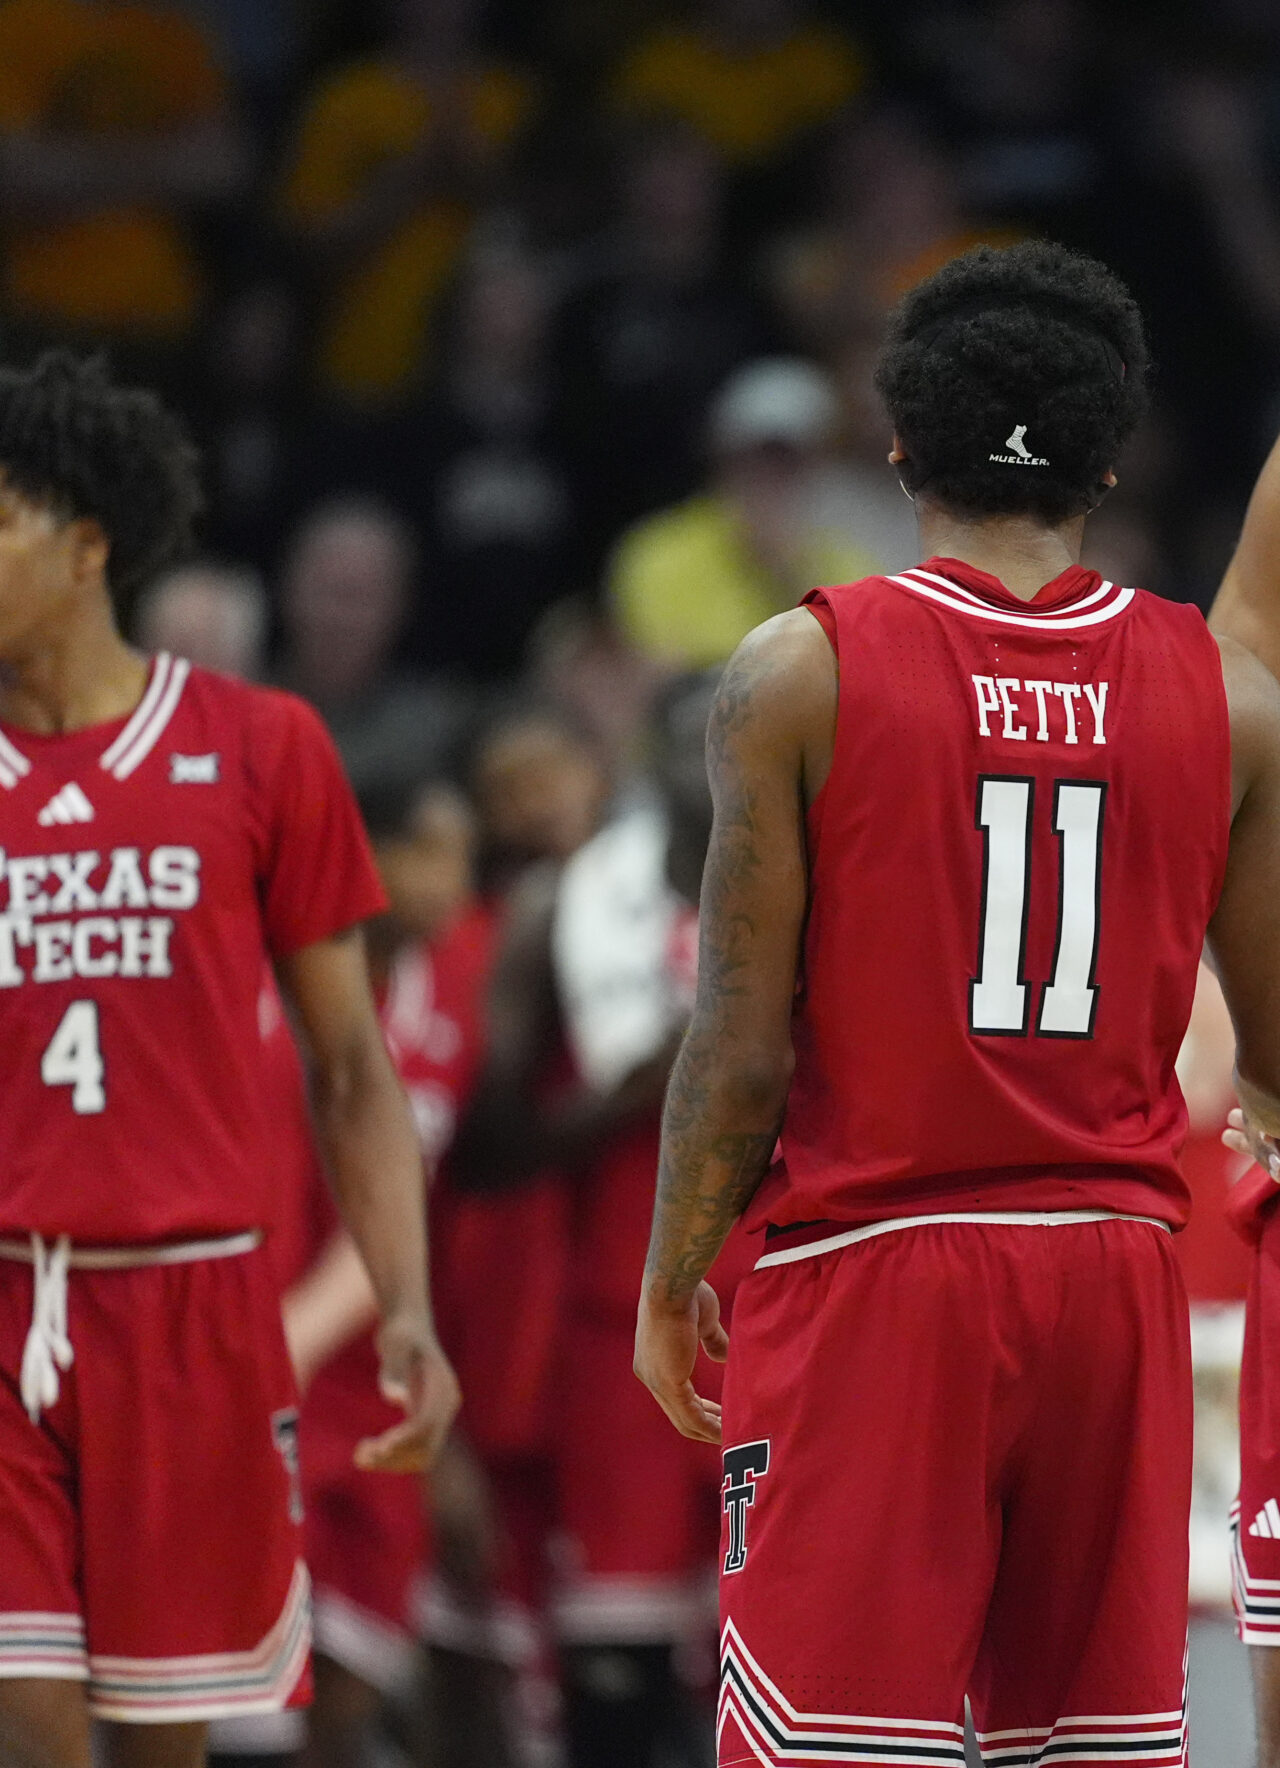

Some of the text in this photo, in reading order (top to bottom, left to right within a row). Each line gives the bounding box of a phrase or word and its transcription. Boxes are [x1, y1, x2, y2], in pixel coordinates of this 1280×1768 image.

[972, 675, 1108, 744] PETTY
[0, 845, 200, 917] EXAS
[969, 774, 1108, 1039] 11
[41, 1000, 105, 1114] 4
